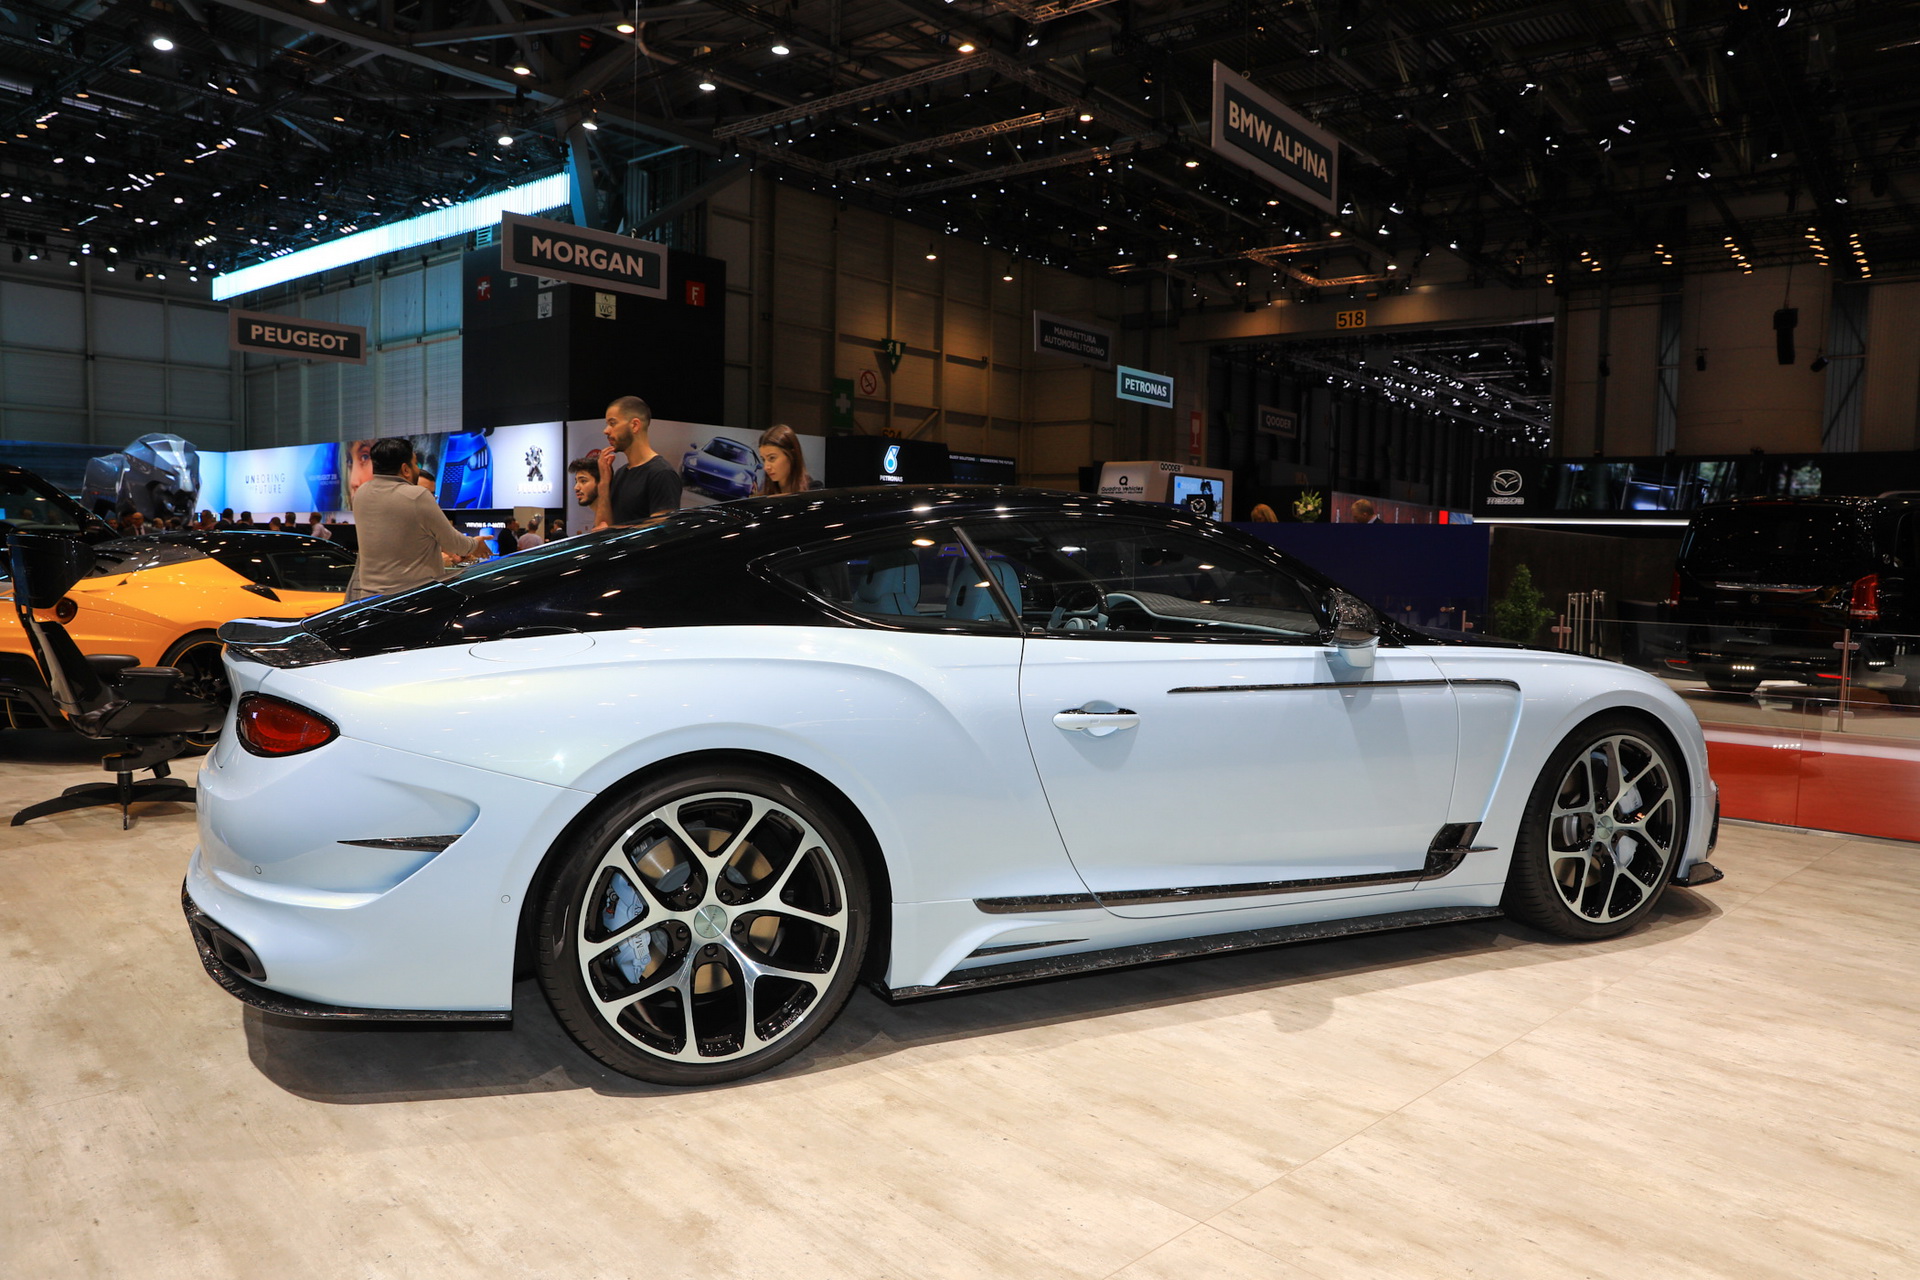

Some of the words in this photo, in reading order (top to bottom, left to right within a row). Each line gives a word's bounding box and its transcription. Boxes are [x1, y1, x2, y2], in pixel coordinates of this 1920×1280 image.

[1228, 99, 1272, 148] BMW
[1273, 130, 1328, 183] ALPINA
[532, 235, 643, 278] MORGAN
[599, 304, 613, 315] WC
[1337, 311, 1364, 328] 518
[250, 324, 349, 351] PEUGEOT
[1053, 326, 1096, 345] MANIFATTURA
[1044, 335, 1082, 351] AUTOMOBILI
[1082, 343, 1105, 357] TORINO
[1124, 377, 1167, 397] PETRONAS
[245, 472, 286, 484] UNBORING
[254, 483, 281, 494] FUTURE
